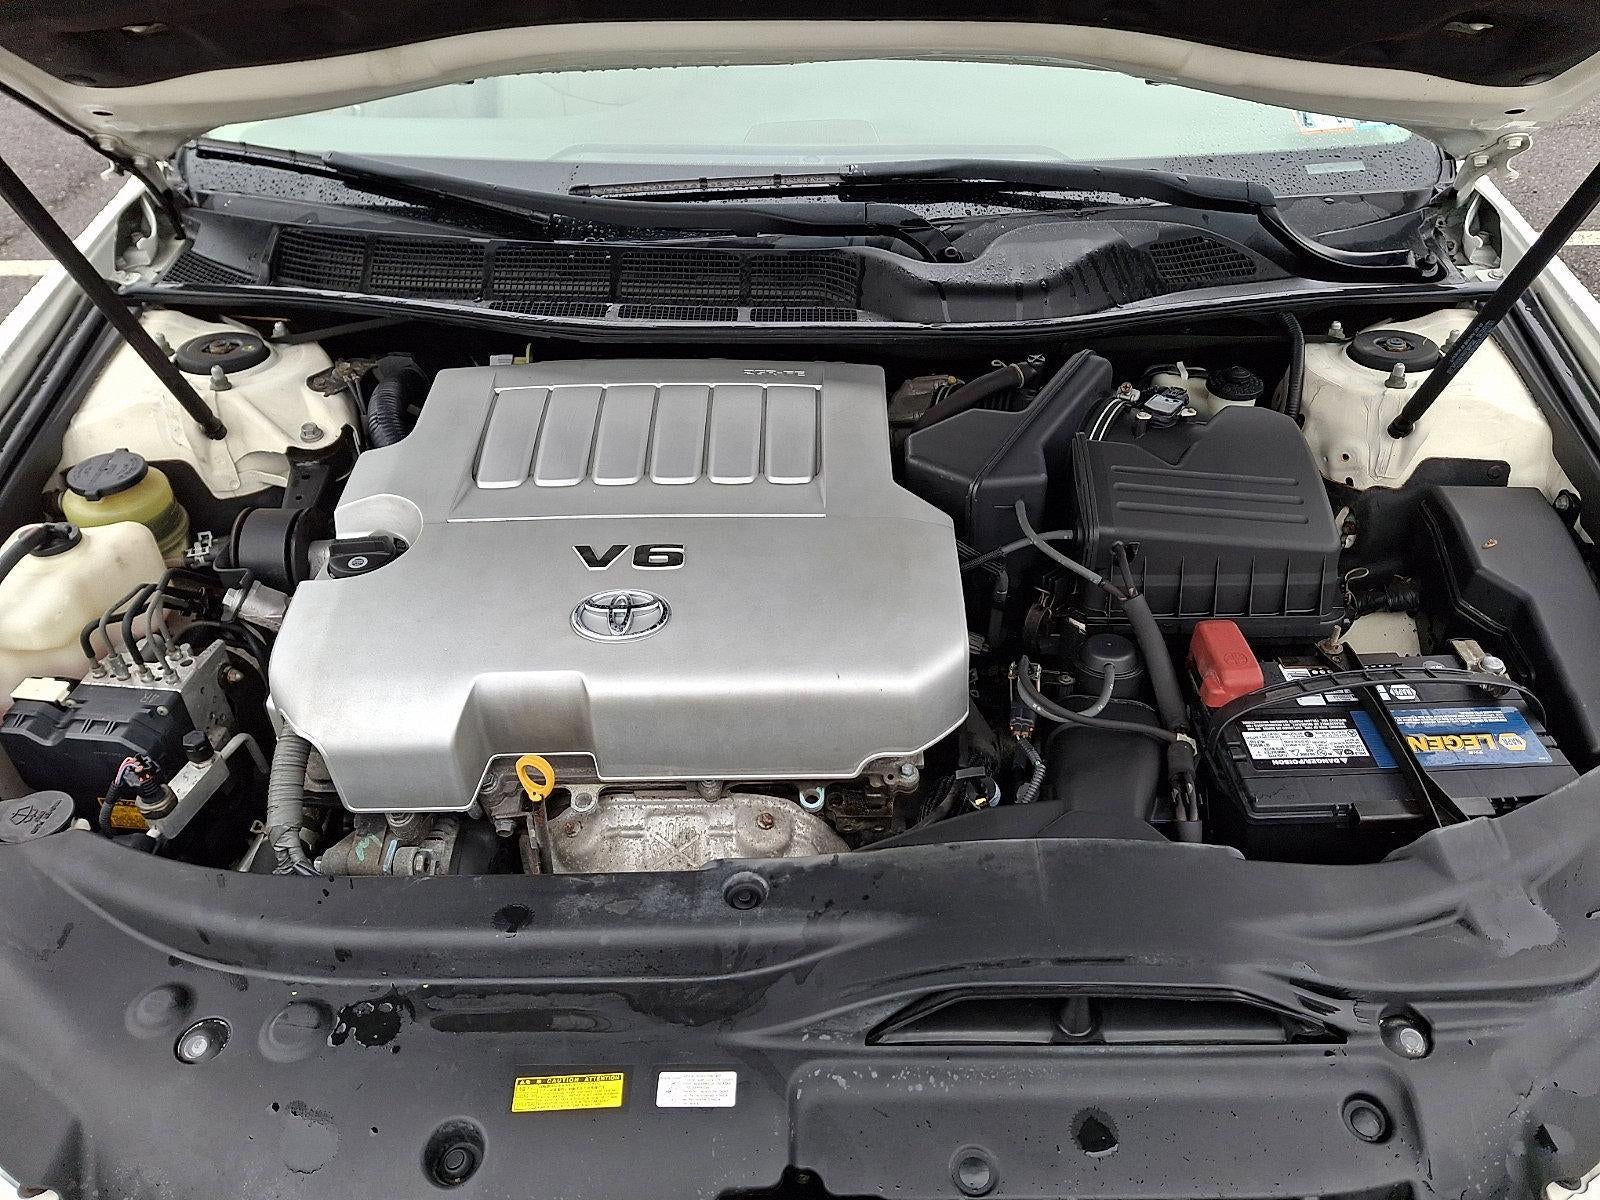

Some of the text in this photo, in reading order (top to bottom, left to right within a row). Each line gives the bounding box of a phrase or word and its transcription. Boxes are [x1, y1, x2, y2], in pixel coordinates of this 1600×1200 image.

[571, 543, 686, 571] V6
[1406, 733, 1496, 751] LEGEN
[1501, 737, 1523, 746] NAPA
[546, 1077, 580, 1085] CAUTION
[584, 1074, 620, 1083] ATTENTION
